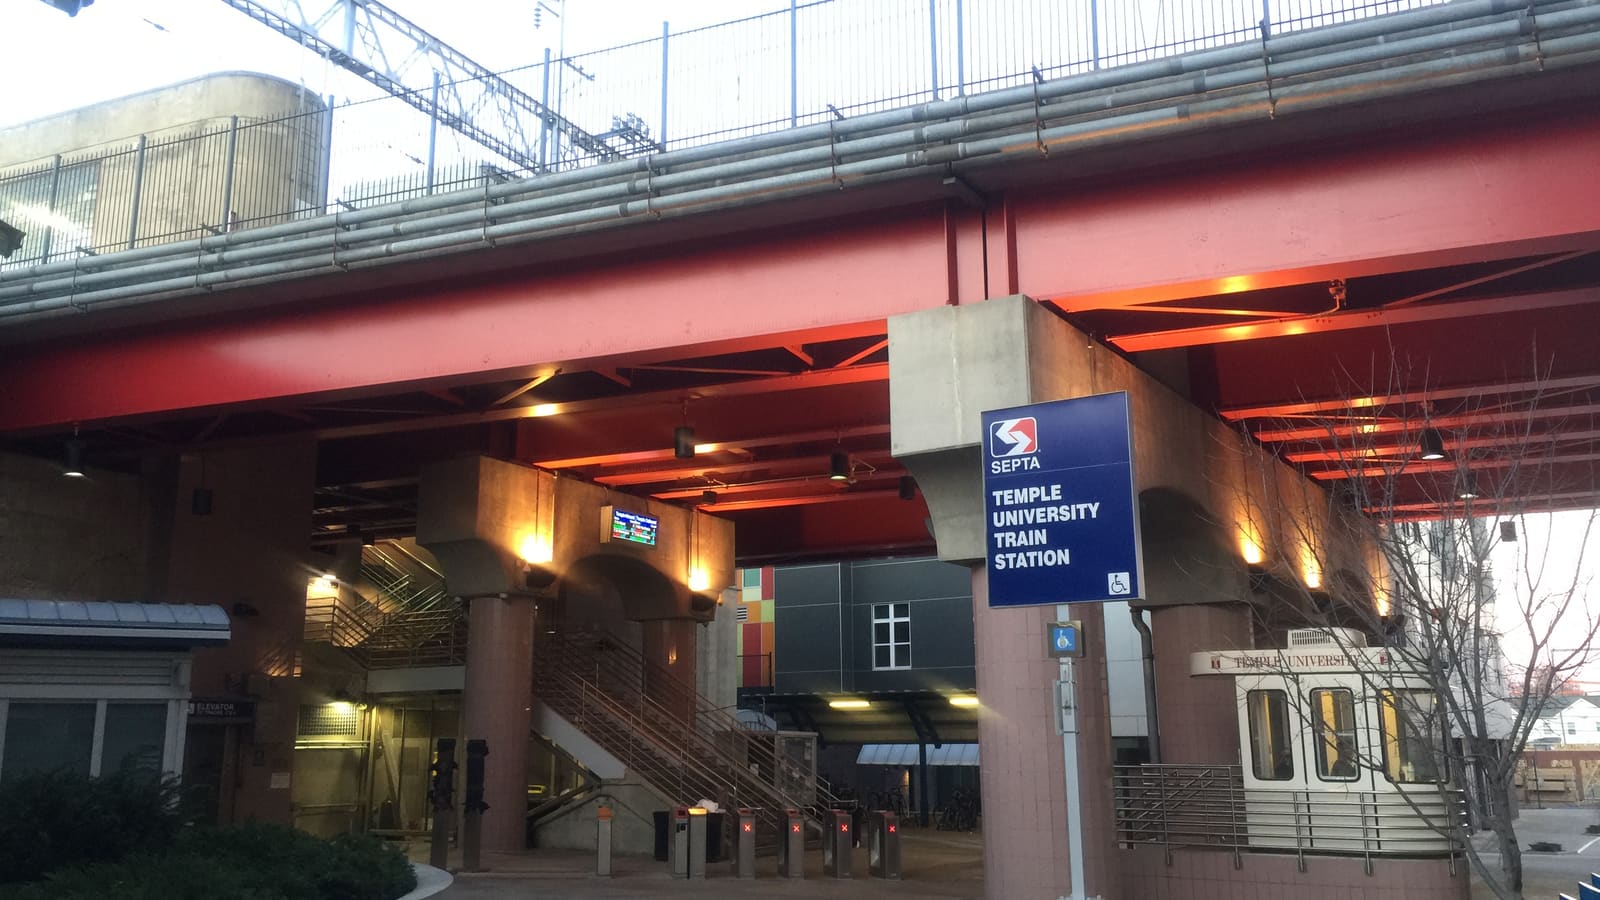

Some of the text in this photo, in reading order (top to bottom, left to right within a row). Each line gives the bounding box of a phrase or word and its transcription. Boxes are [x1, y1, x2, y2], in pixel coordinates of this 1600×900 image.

[991, 457, 1041, 474] SEPTA
[992, 485, 1062, 506] TEMPLE
[993, 503, 1100, 527] UNIVERSITY
[994, 529, 1047, 549] TRAIN
[995, 549, 1070, 570] STATION
[1234, 655, 1360, 668] TEMPLE UNIVERSITY
